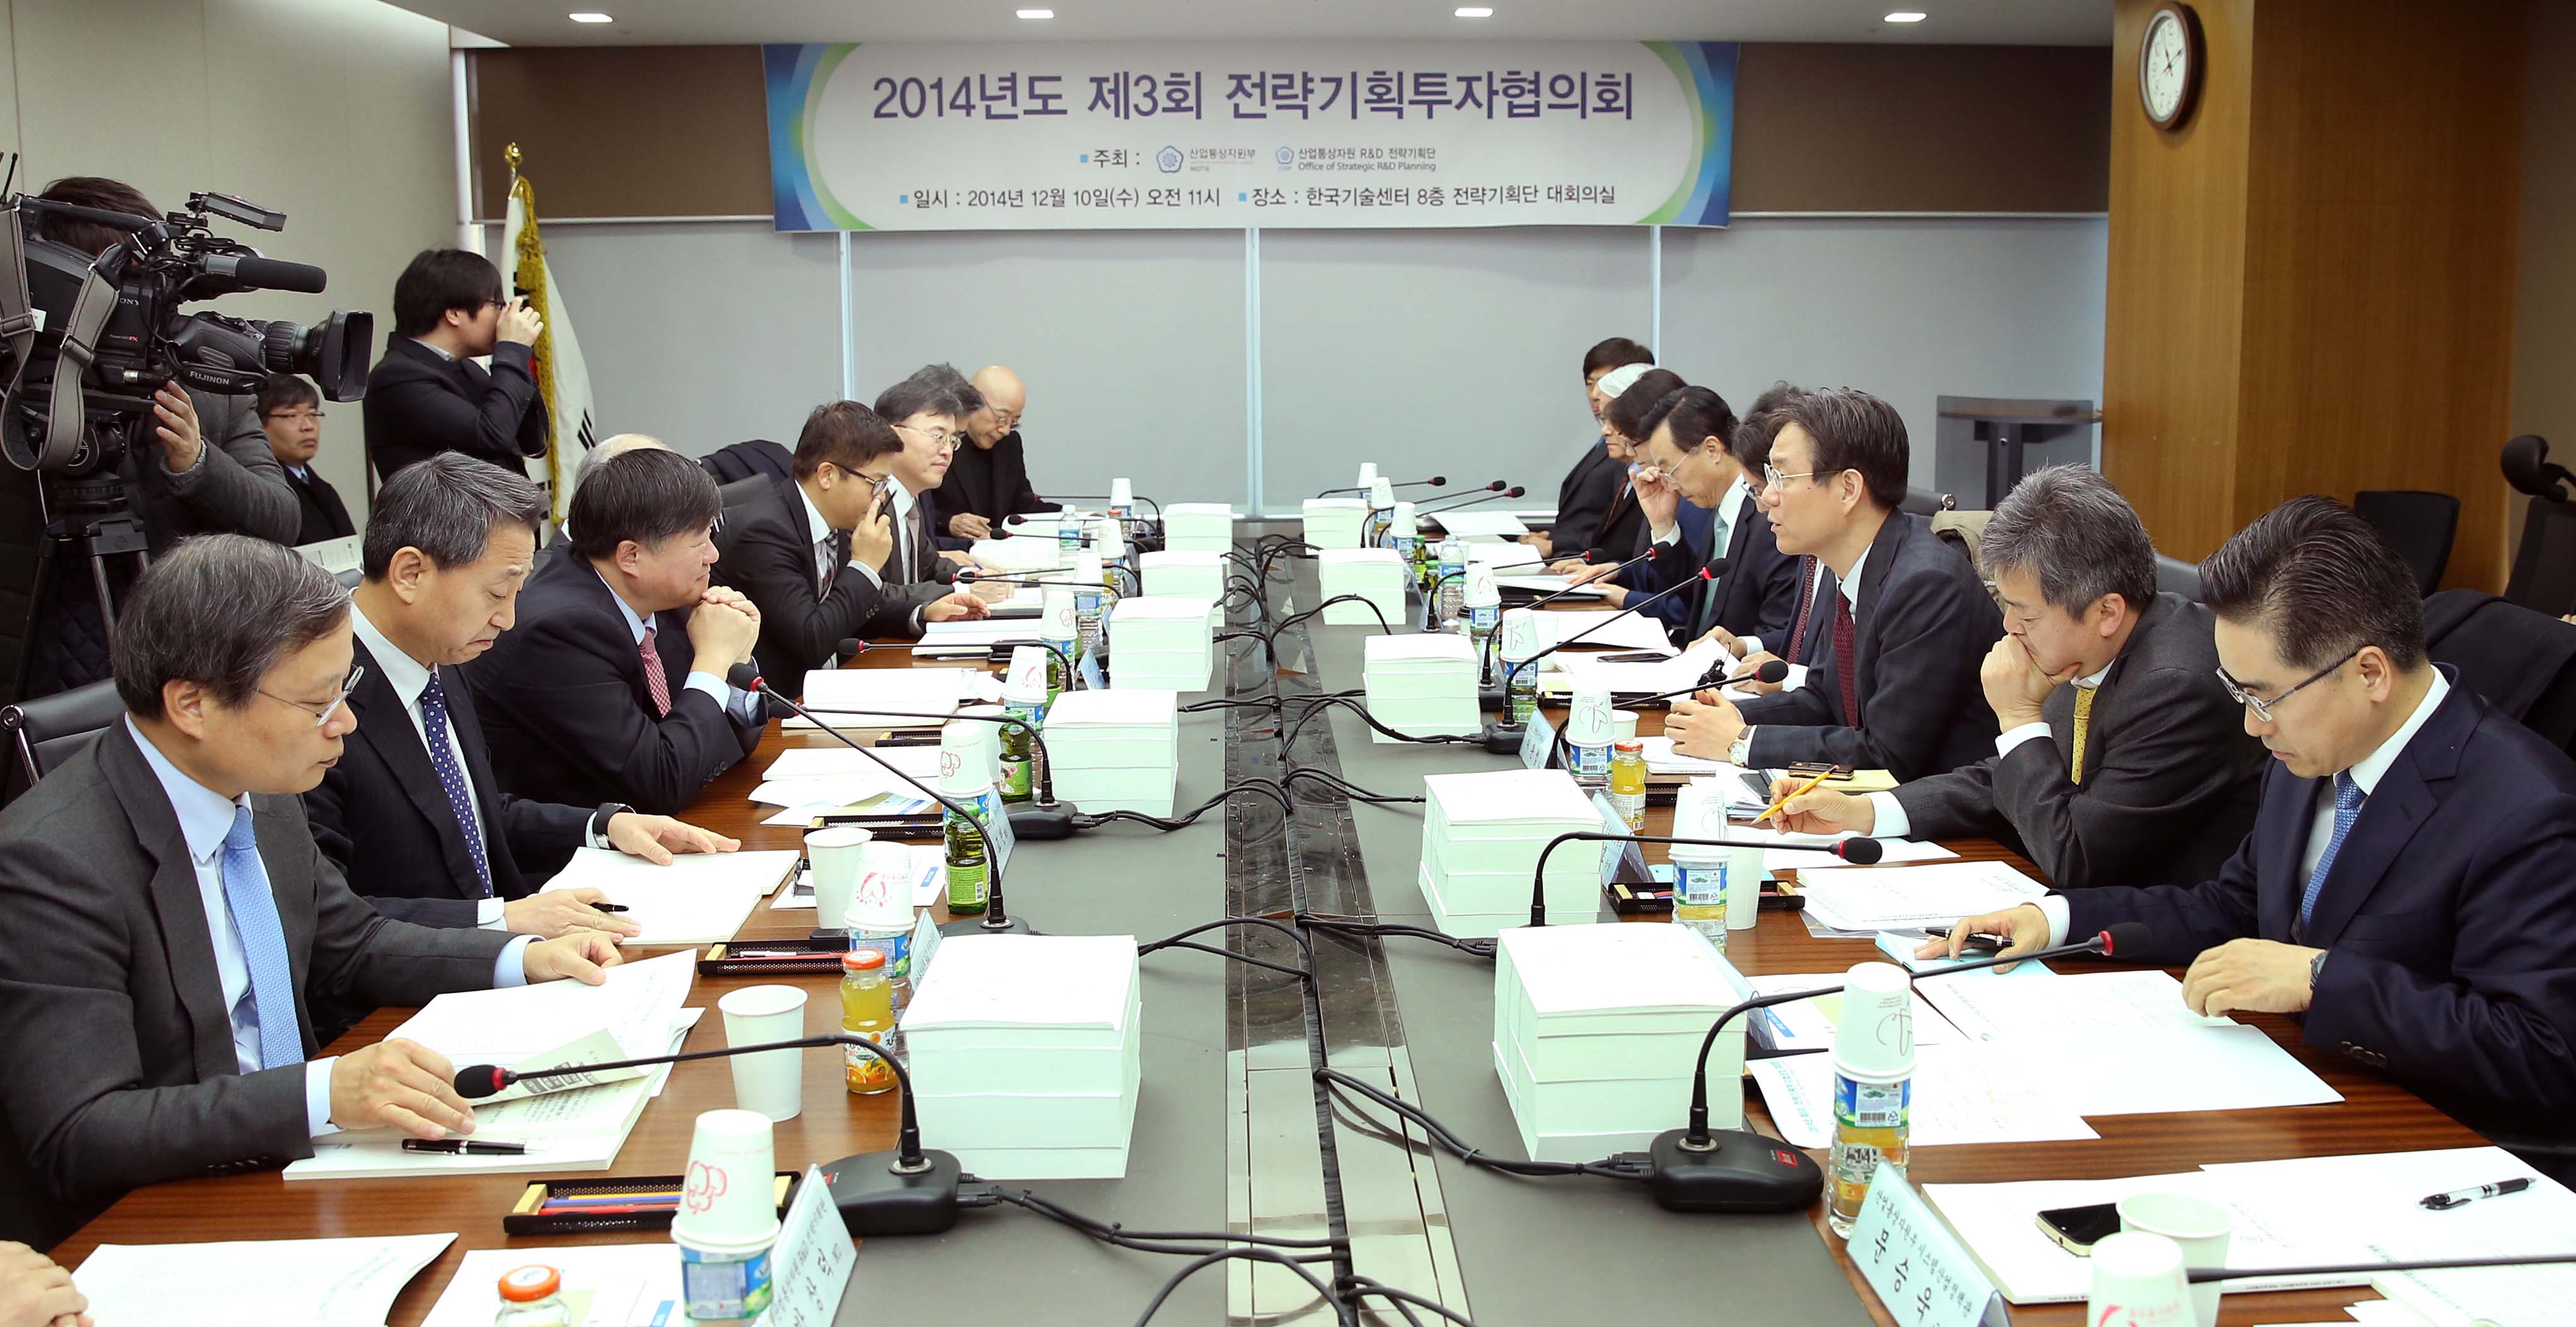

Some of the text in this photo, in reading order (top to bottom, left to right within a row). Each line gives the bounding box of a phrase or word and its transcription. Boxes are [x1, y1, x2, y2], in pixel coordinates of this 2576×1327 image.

[873, 69, 1633, 120] 2014년도 제3회 전략기획투자협의회
[1093, 149, 1127, 168] 주최
[1360, 148, 1384, 159] R&D
[1388, 147, 1436, 159] 전략기획단
[1298, 161, 1324, 171] Office
[1326, 161, 1336, 171] of
[1336, 161, 1375, 173] Strategic
[1377, 161, 1396, 171] R&D
[1398, 161, 1437, 173] Planning
[914, 189, 948, 209] 일시
[968, 189, 1024, 208] 2014년
[1032, 188, 1066, 208] 12월
[1073, 187, 1139, 208] 10일(수)
[1146, 187, 1181, 207] 오전
[1187, 187, 1220, 208] 11시
[1252, 187, 1286, 208] 장소
[1306, 187, 1409, 207] 한국기술센터
[1417, 187, 1445, 207] 8층
[1453, 185, 1539, 206] 전략기획단
[1547, 184, 1615, 204] 대회의실
[119, 297, 139, 306] ONY
[189, 371, 230, 385] FUJINON
